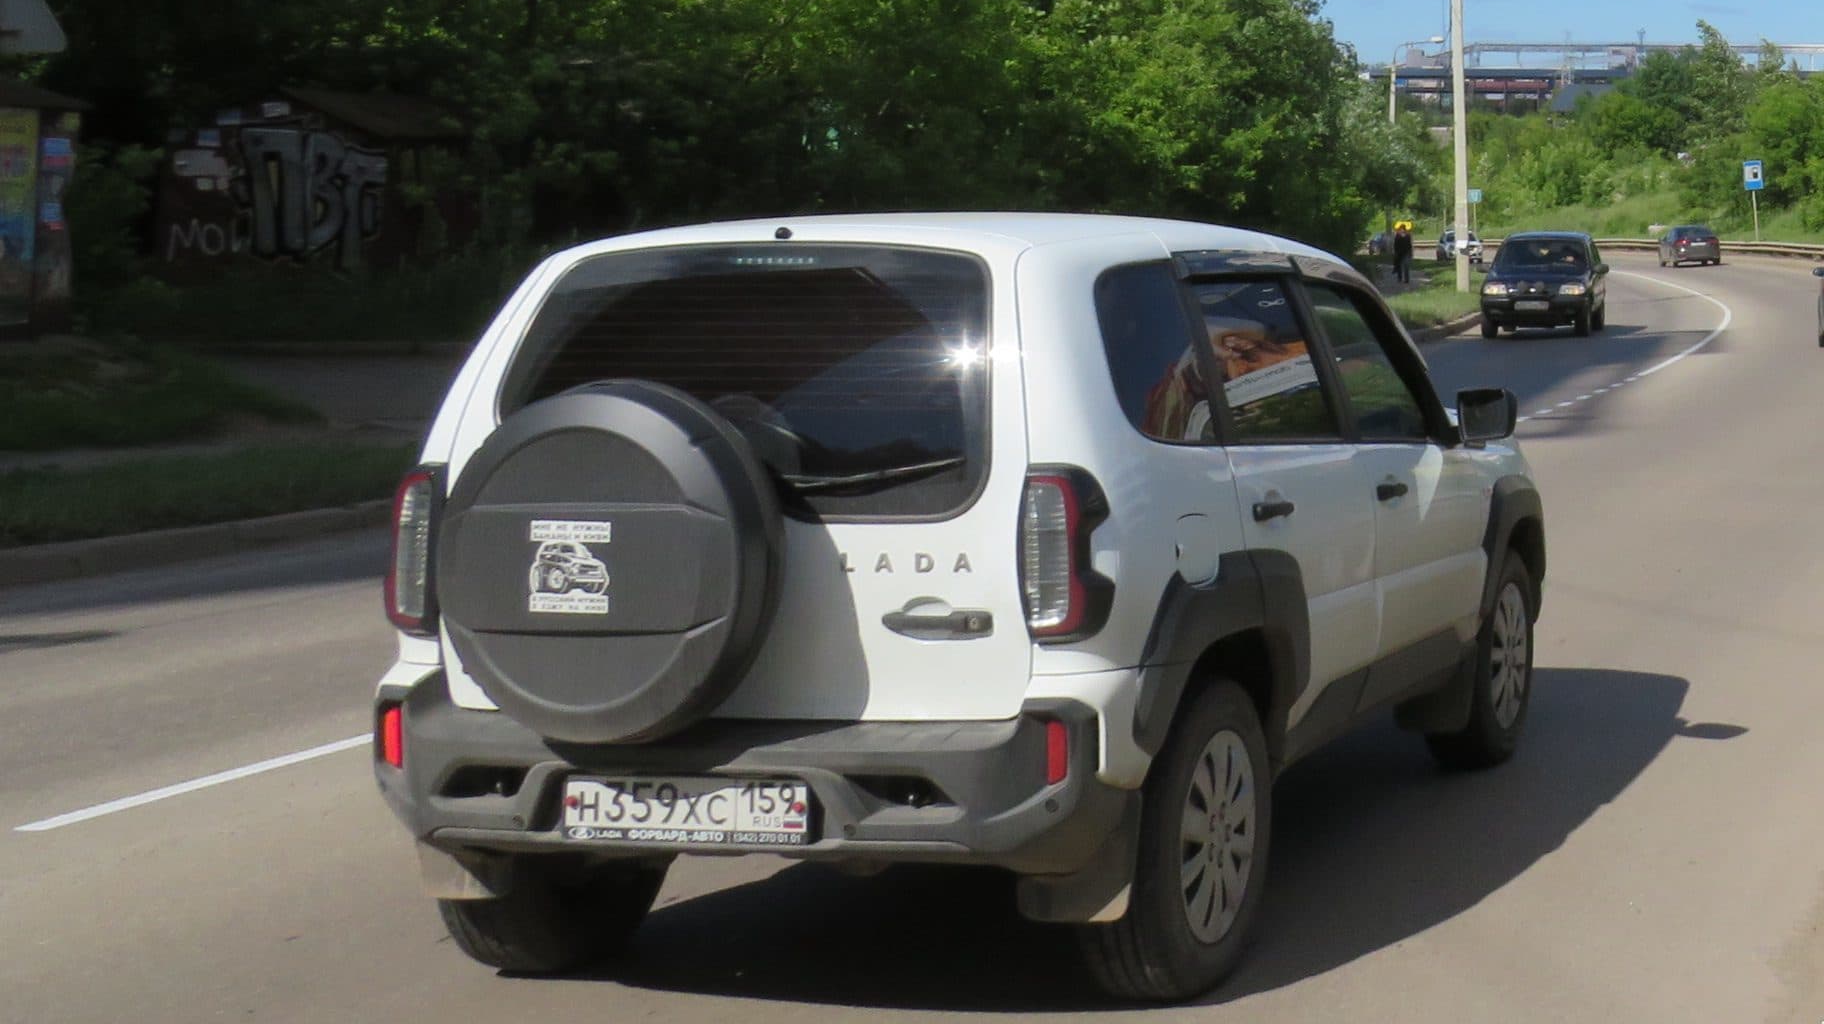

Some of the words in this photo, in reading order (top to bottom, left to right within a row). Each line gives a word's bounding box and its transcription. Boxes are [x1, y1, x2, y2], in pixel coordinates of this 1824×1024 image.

[838, 551, 973, 574] LADA
[740, 782, 796, 815] 159
[752, 815, 782, 828] RUS
